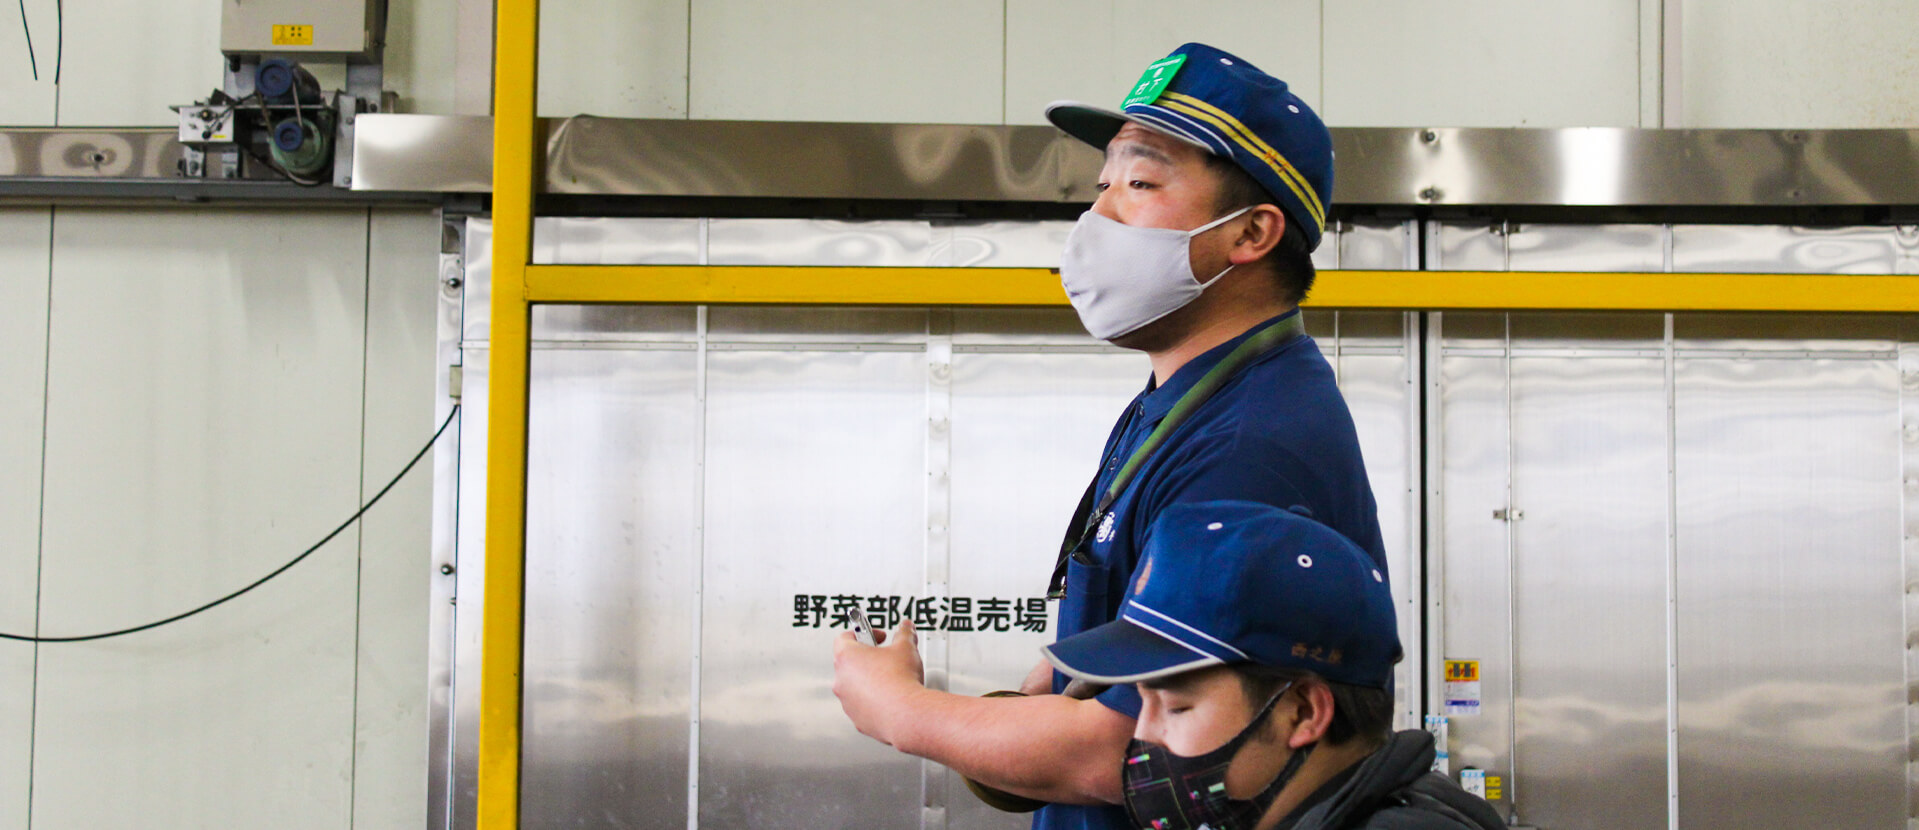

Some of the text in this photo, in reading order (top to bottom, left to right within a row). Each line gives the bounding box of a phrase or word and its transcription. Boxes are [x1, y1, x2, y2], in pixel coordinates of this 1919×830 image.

[792, 594, 1048, 633] 野菜部低温売場
